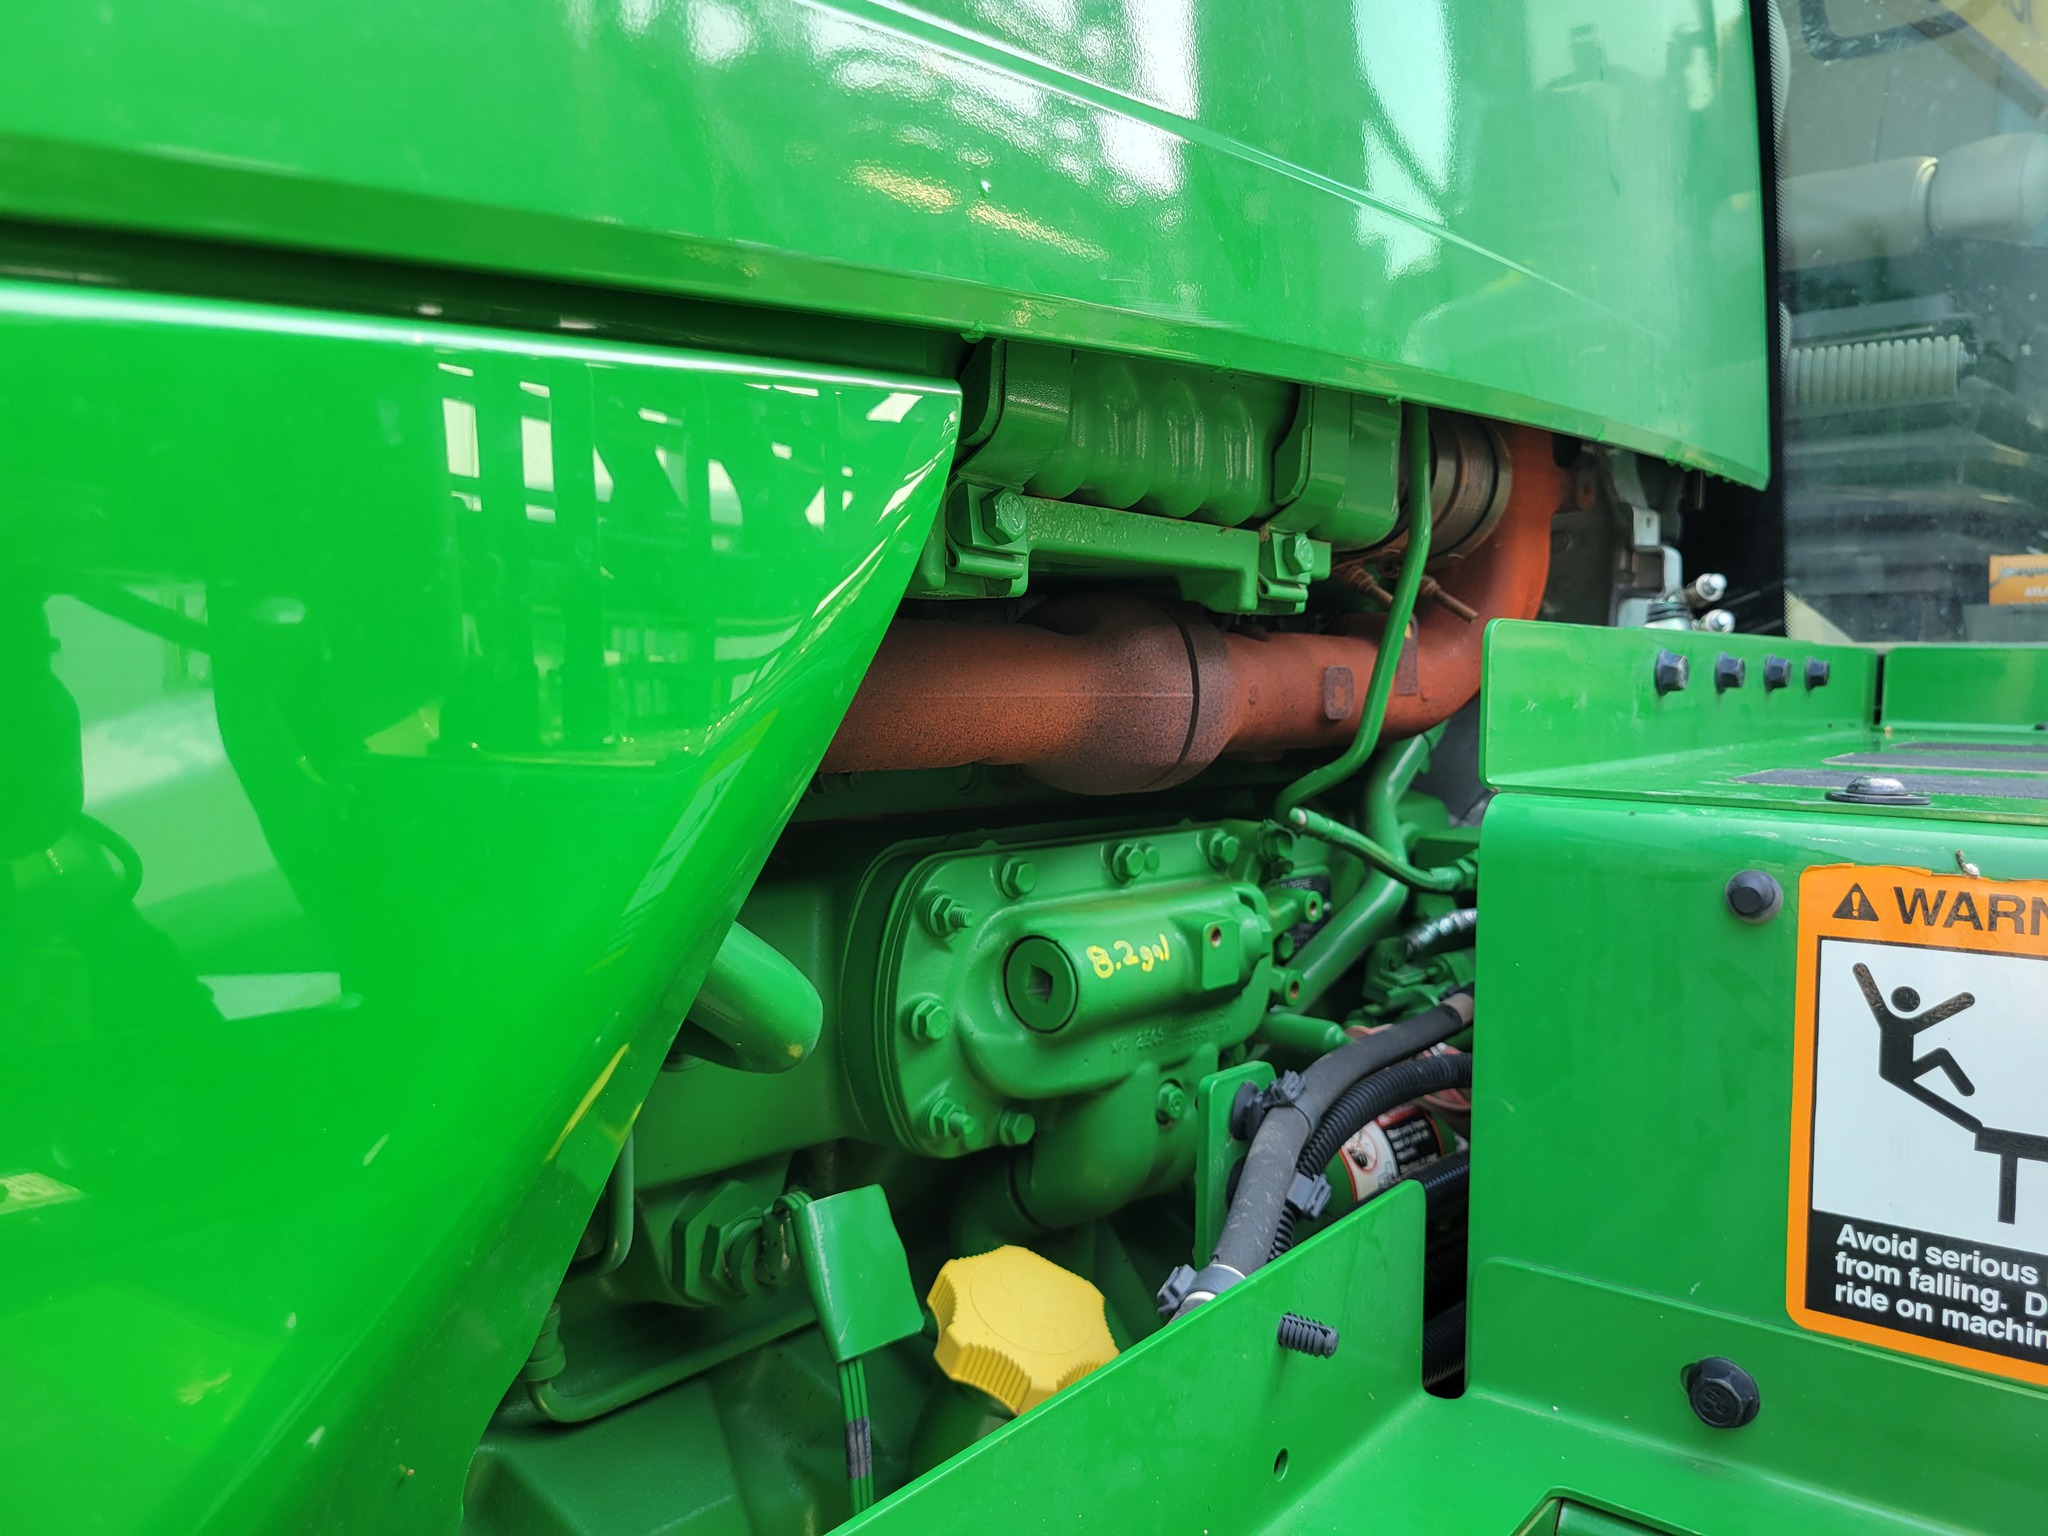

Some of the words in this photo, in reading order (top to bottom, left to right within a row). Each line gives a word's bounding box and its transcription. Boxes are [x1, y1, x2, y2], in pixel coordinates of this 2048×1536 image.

[1835, 1251, 1901, 1286] from
[1908, 1266, 2008, 1313] falling.
[1836, 1223, 1918, 1261] Avoid
[1925, 1246, 2039, 1285] serious
[1835, 1281, 1889, 1312] ride
[1896, 1298, 1933, 1323] on
[1942, 1307, 2048, 1350] machin
